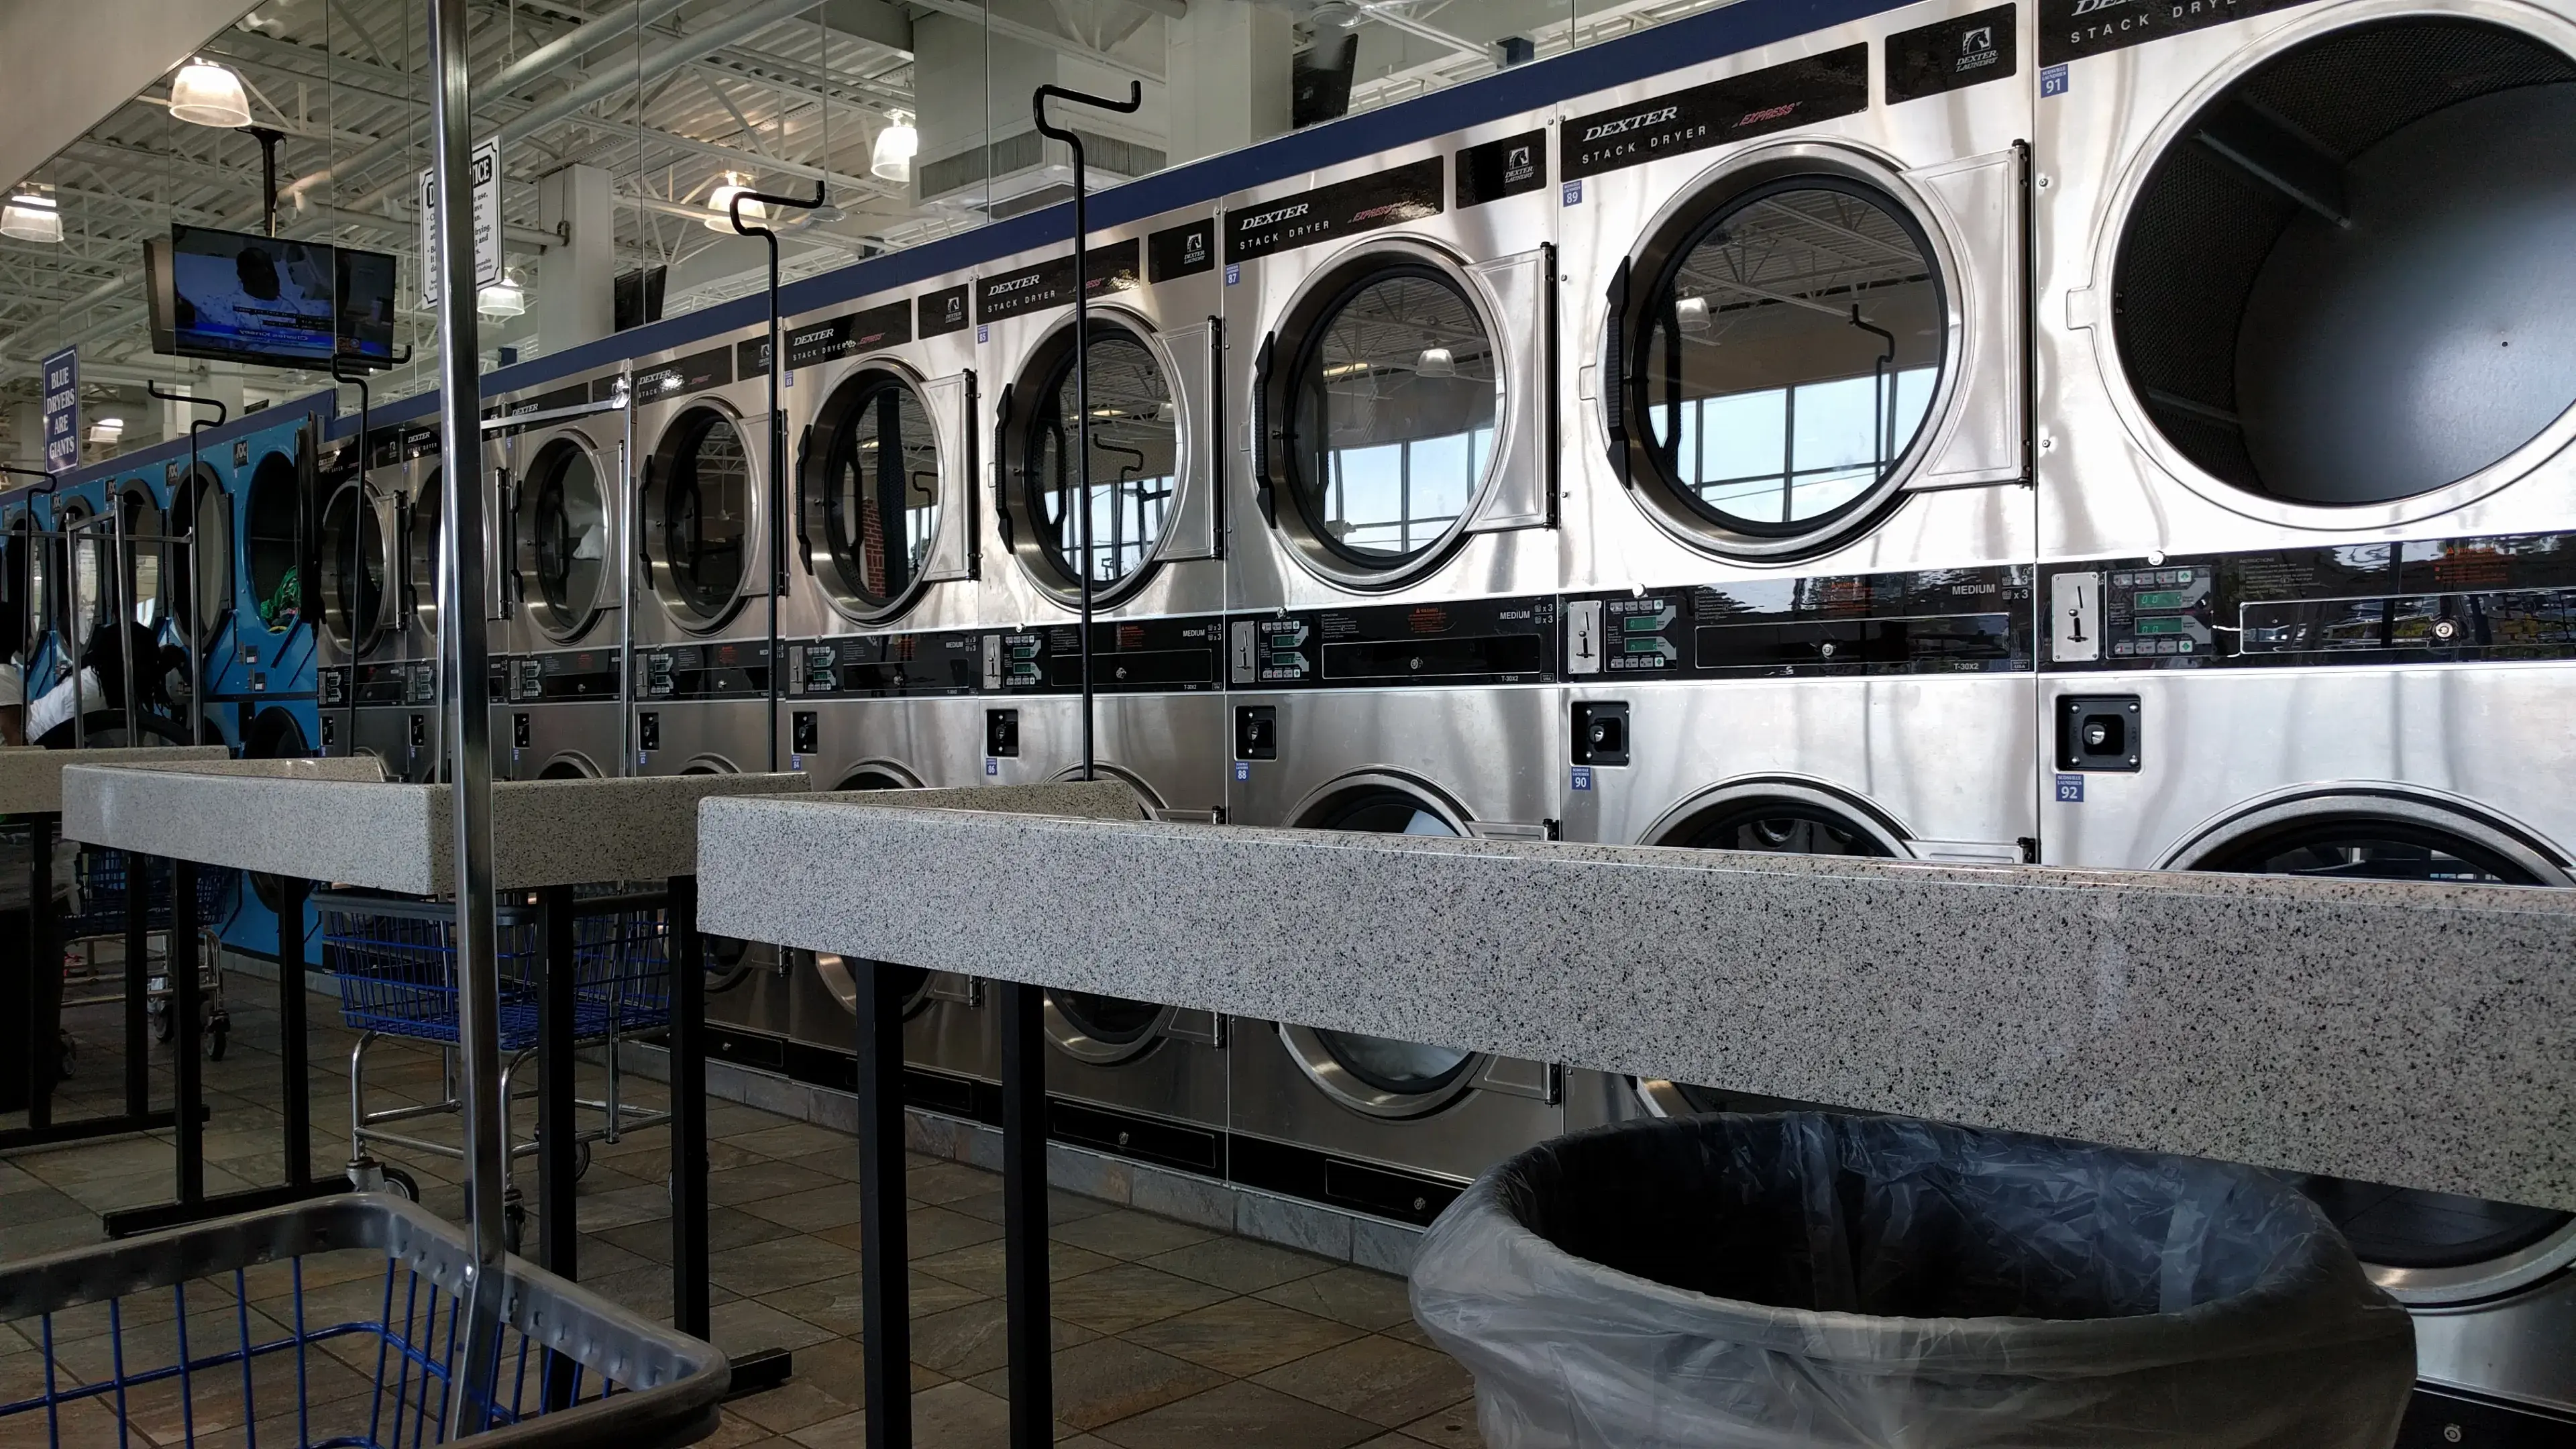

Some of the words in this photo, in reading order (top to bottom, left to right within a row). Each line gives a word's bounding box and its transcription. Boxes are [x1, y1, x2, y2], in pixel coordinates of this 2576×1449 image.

[2071, 14, 2149, 44] STACK
[1955, 56, 1998, 72] LAUNDRY
[1956, 50, 1997, 66] DEXTER
[2046, 78, 2061, 94] 91
[1582, 106, 1678, 142] DEXTER
[1738, 103, 1796, 127] EXPRESS
[1582, 142, 1635, 164] STACK
[1650, 125, 1707, 148] DRYER
[1505, 166, 1534, 178] DEXTER
[1505, 172, 1534, 183] LAUNDRY
[1566, 191, 1578, 204] 89
[1240, 203, 1309, 230] DEXTER
[1240, 232, 1279, 250] STACK
[1289, 220, 1330, 238] DRYER
[1184, 250, 1205, 260] DEXTER
[987, 274, 1040, 297] DEXTER
[1228, 273, 1237, 284] 87
[987, 299, 1018, 313] STACK
[1024, 290, 1056, 304] DRYER
[793, 328, 834, 347] DEXTER
[792, 350, 817, 362] STACK
[822, 342, 847, 354] DRYER
[51, 366, 70, 390] BLUE
[639, 369, 672, 386] DEXTER
[786, 378, 792, 386] 83
[46, 388, 75, 415] DRYERS
[512, 402, 539, 417] DEXTER
[54, 414, 69, 435] ARE
[408, 431, 431, 443] DEXTER
[49, 436, 75, 460] GIANTS
[2022, 576, 2029, 585] 3
[1952, 584, 1996, 595] MEDIUM
[2021, 589, 2029, 599] 3
[1499, 610, 1530, 620] MEDIUM
[1548, 603, 1553, 612] 3
[1548, 615, 1553, 623] 3
[988, 765, 995, 773] 86
[1238, 769, 1246, 780] 88
[1575, 777, 1587, 788] 90
[2061, 786, 2078, 799] 92
